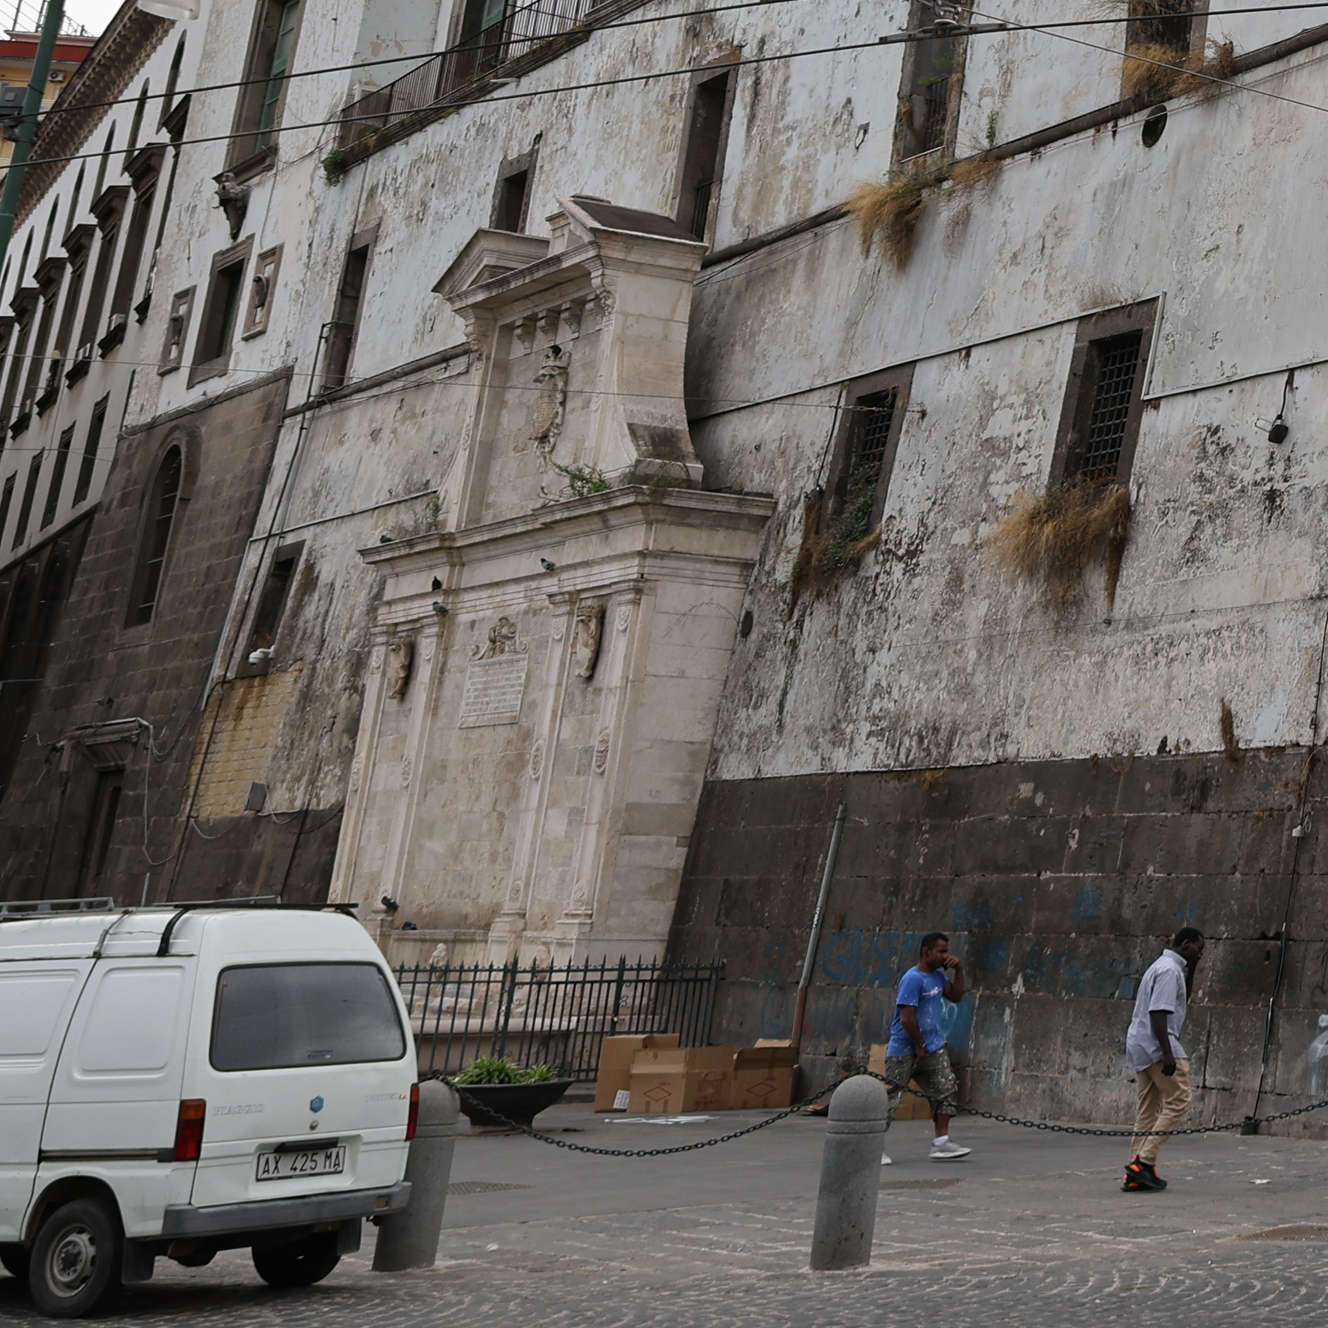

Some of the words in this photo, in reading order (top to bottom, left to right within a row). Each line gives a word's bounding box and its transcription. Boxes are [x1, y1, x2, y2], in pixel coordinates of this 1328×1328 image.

[262, 1155, 280, 1175] AX
[290, 1151, 318, 1172] 425
[322, 1149, 341, 1170] MA
